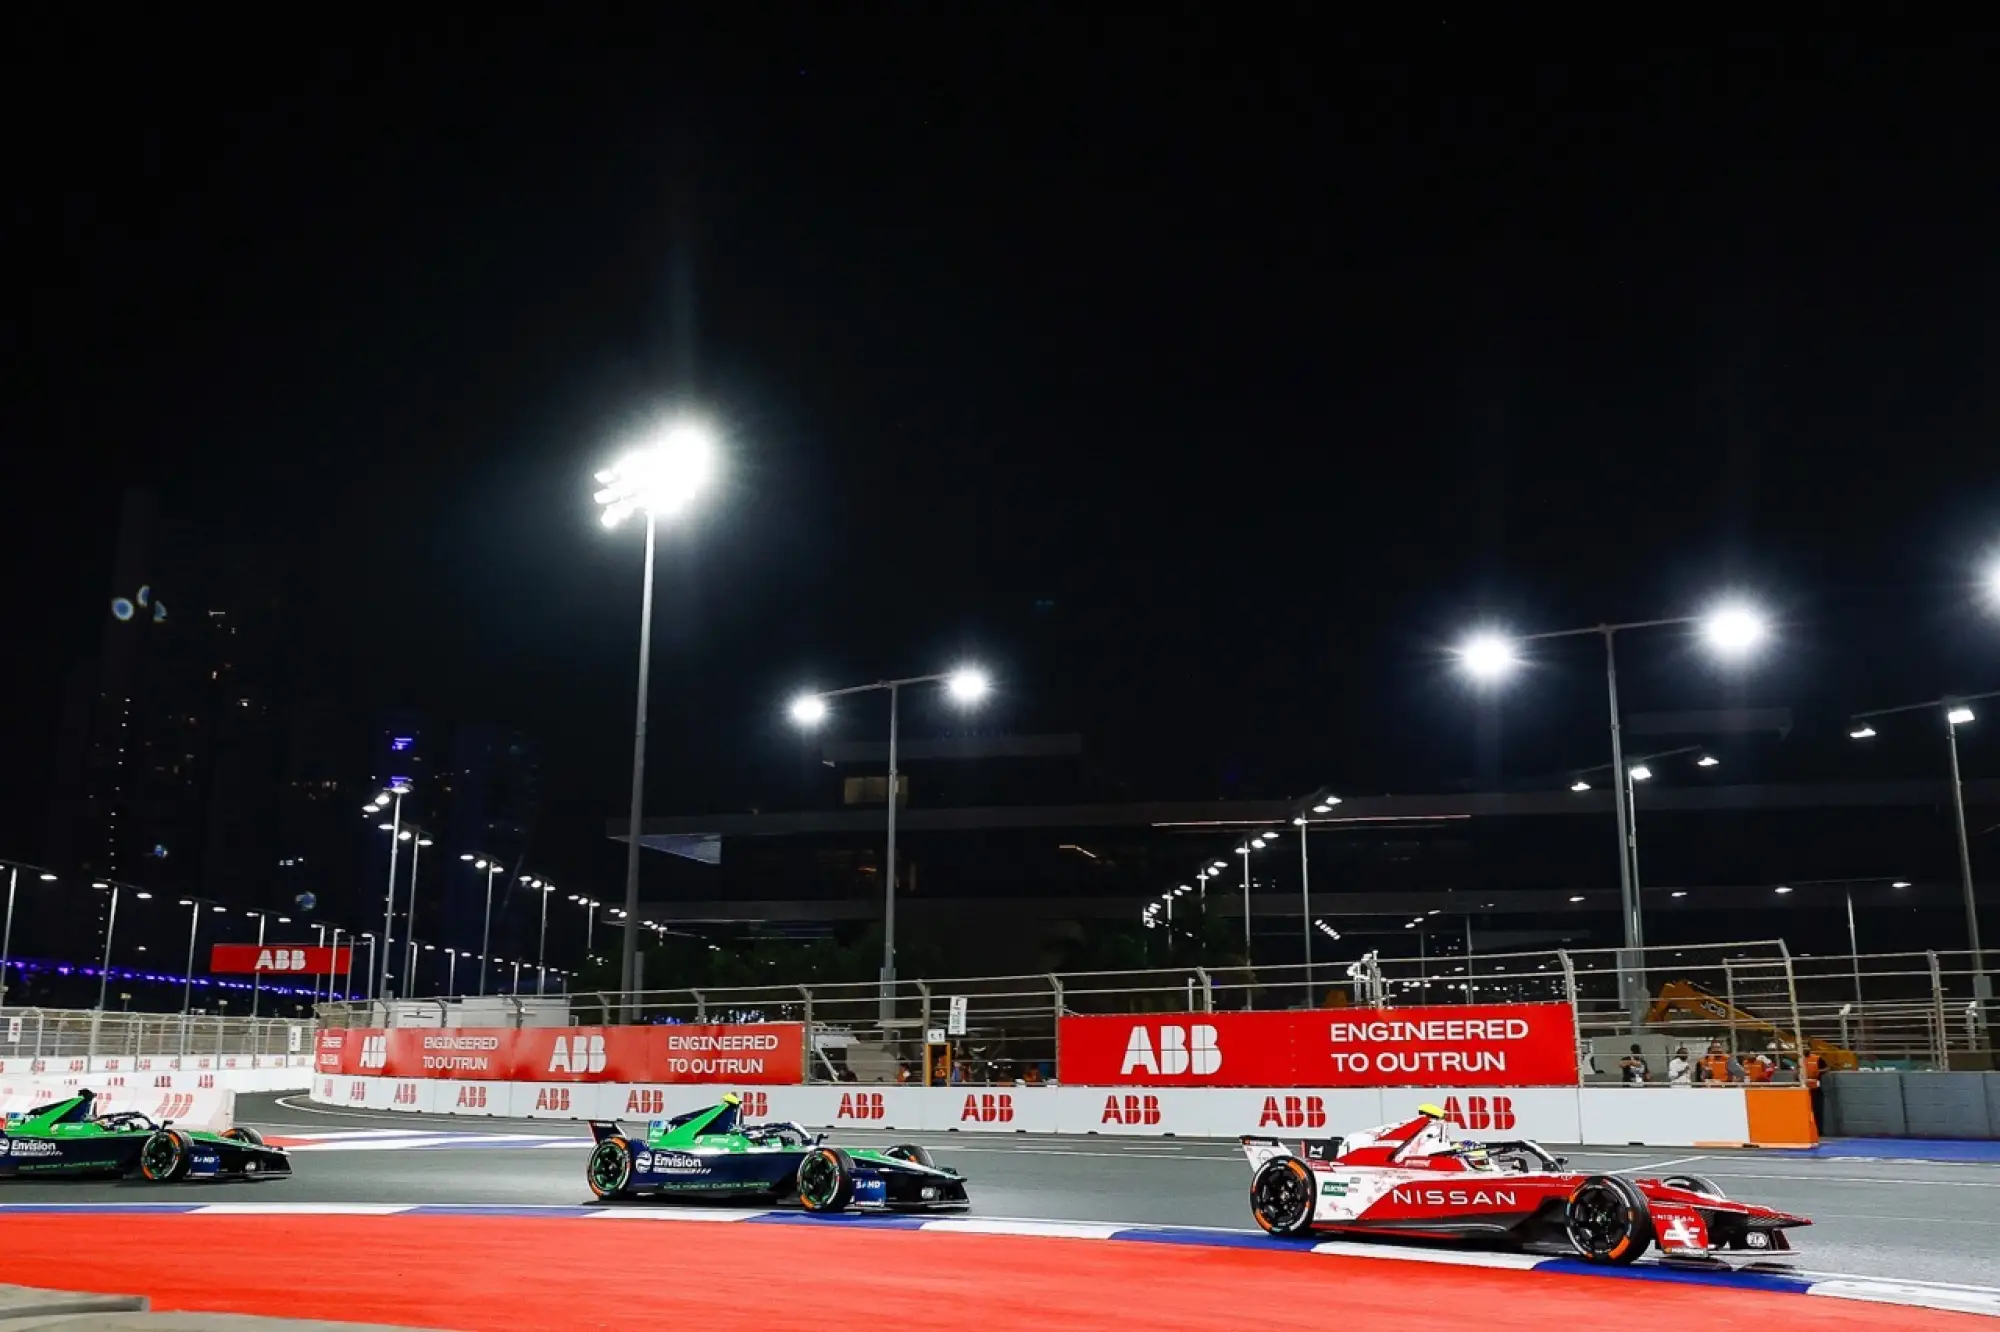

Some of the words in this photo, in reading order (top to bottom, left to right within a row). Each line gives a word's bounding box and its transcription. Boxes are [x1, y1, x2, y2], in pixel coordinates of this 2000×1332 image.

[255, 949, 306, 970] ABB
[1331, 1019, 1529, 1042] ENGINEERED
[360, 1035, 387, 1068] ABB
[424, 1036, 498, 1050] ENGINEERED
[669, 1034, 779, 1051] ENGINEERED
[1121, 1025, 1222, 1075] ABB
[423, 1056, 435, 1069] TO
[436, 1056, 488, 1070] OUTRUN
[547, 1034, 607, 1074] ABB
[1331, 1053, 1368, 1072] TO
[1376, 1051, 1506, 1072] OUTRUN
[668, 1058, 688, 1074] TO
[692, 1058, 763, 1074] OUTRUN
[393, 1084, 416, 1104] ABB
[458, 1087, 486, 1107] ABB
[536, 1089, 570, 1110] ABB
[626, 1090, 664, 1113] ABB
[742, 1092, 767, 1116] BB
[837, 1093, 886, 1120] ABB
[961, 1094, 1015, 1123] ABB
[1101, 1096, 1162, 1126] ABB
[1258, 1096, 1328, 1128] ABB
[1443, 1096, 1517, 1130] ABB
[11, 1139, 56, 1151] Envision
[654, 1153, 702, 1168] Envision
[1393, 1189, 1516, 1205] NISSAN
